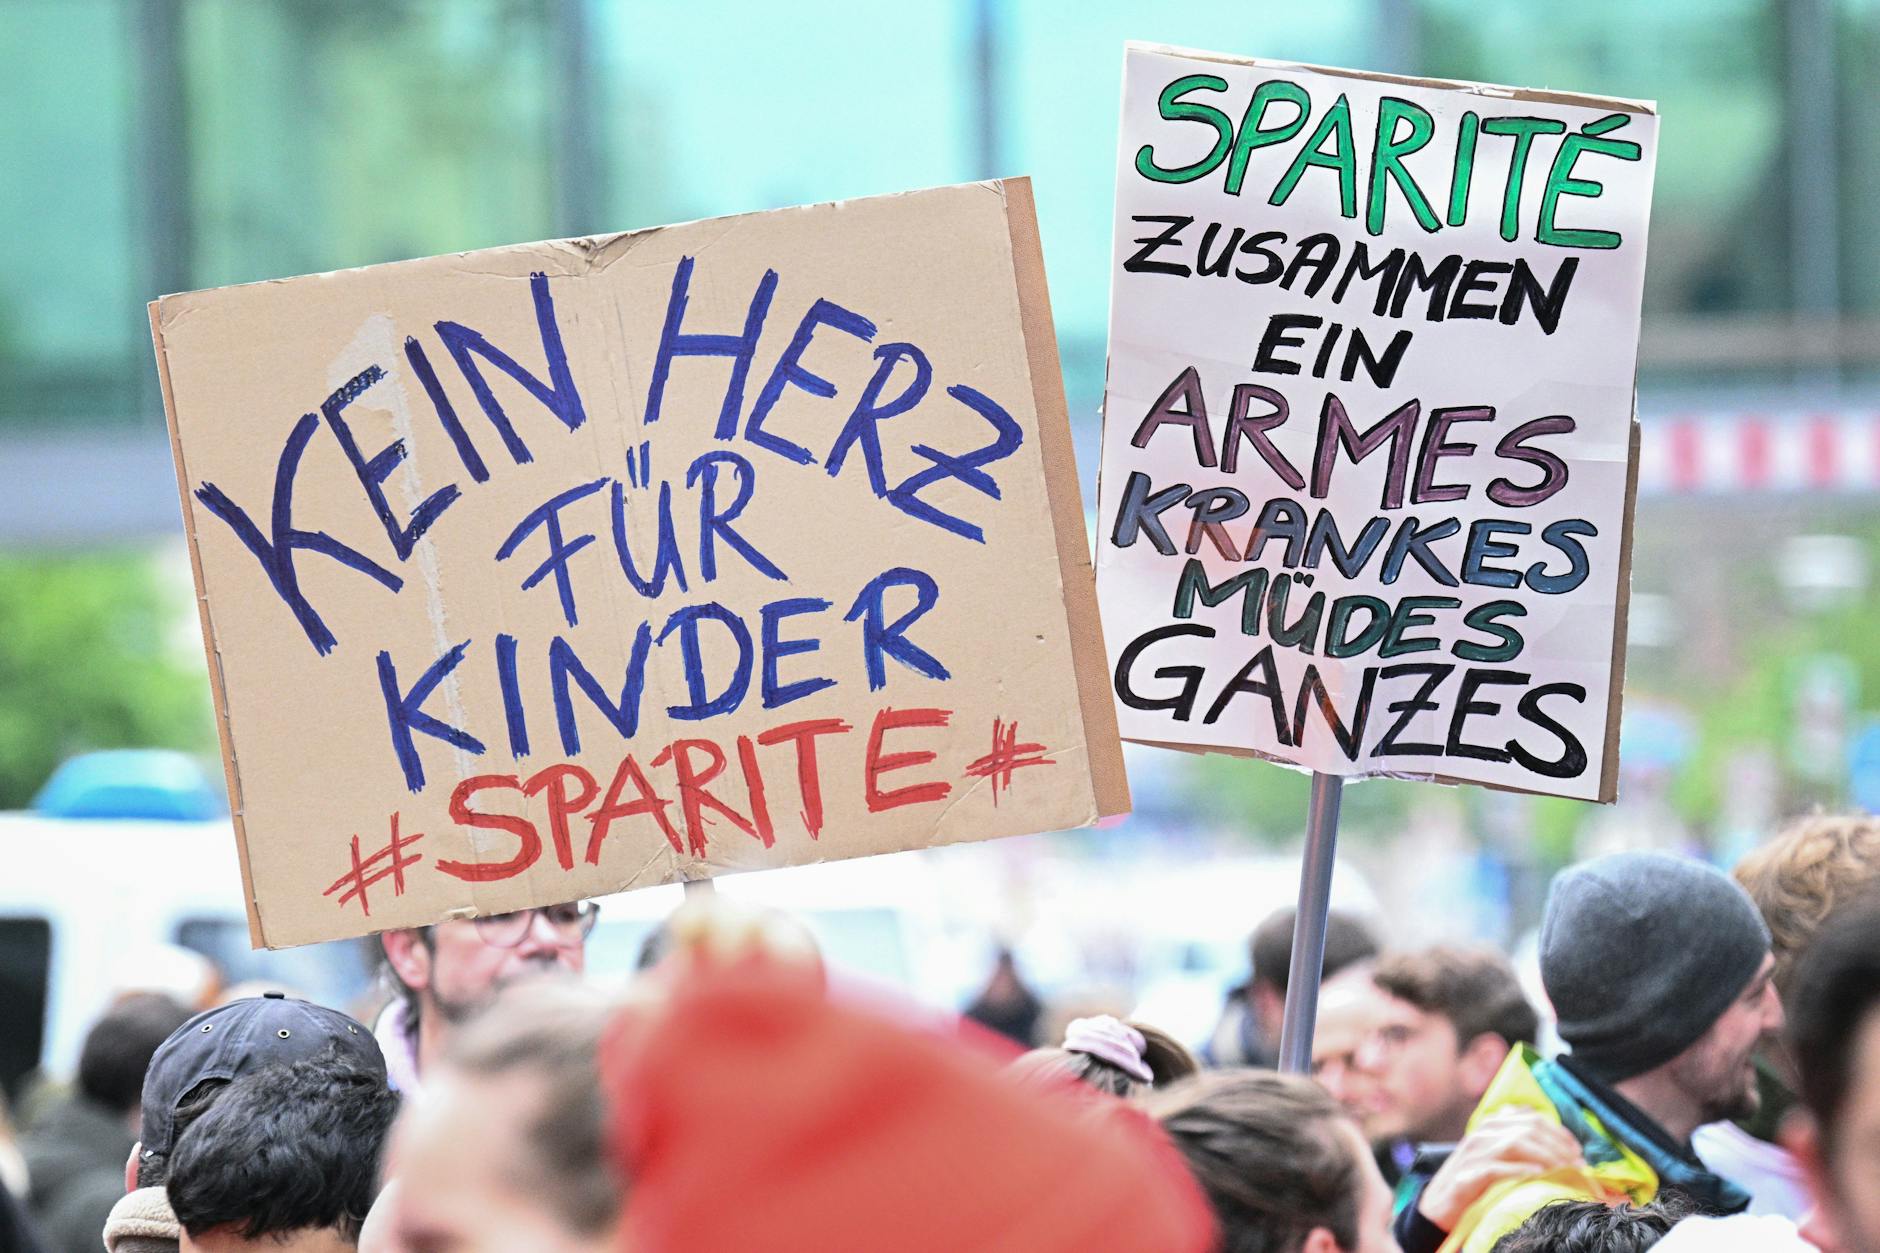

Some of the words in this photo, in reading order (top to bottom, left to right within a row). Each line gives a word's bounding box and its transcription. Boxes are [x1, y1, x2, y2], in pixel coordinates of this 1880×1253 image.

[1135, 74, 1642, 249] SPARITÉ
[1123, 215, 1580, 335] ZUSAMMEN
[1252, 313, 1413, 388] EIN
[195, 272, 587, 656] KEIN
[644, 256, 1025, 545] HERZ
[1130, 366, 1577, 510] ARMES
[495, 441, 788, 627] FÜR
[1111, 471, 1599, 594] KRANKES
[376, 567, 952, 794] KINDER
[1173, 558, 1528, 662] MÜDES
[1114, 623, 1589, 779] GANZES
